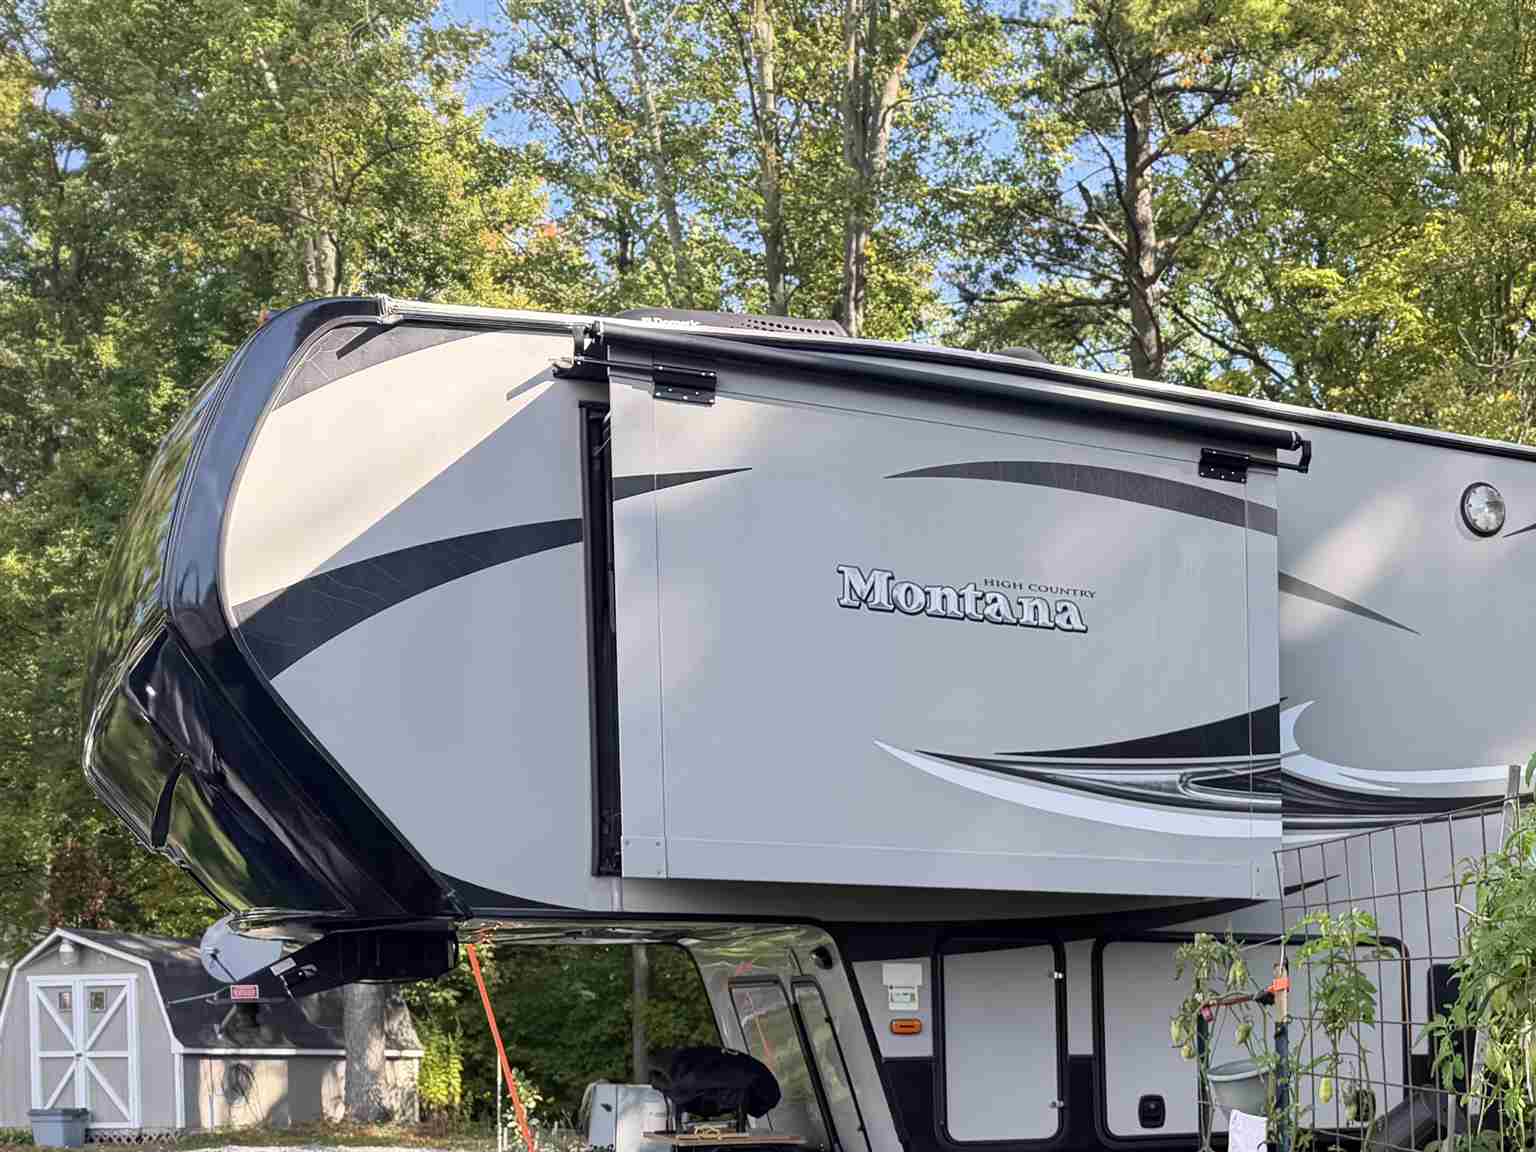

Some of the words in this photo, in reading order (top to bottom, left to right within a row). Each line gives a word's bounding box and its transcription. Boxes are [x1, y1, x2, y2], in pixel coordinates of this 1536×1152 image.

[837, 564, 1088, 632] Montana
[984, 578, 1024, 591] HIGH
[1028, 583, 1096, 599] COUNTRY
